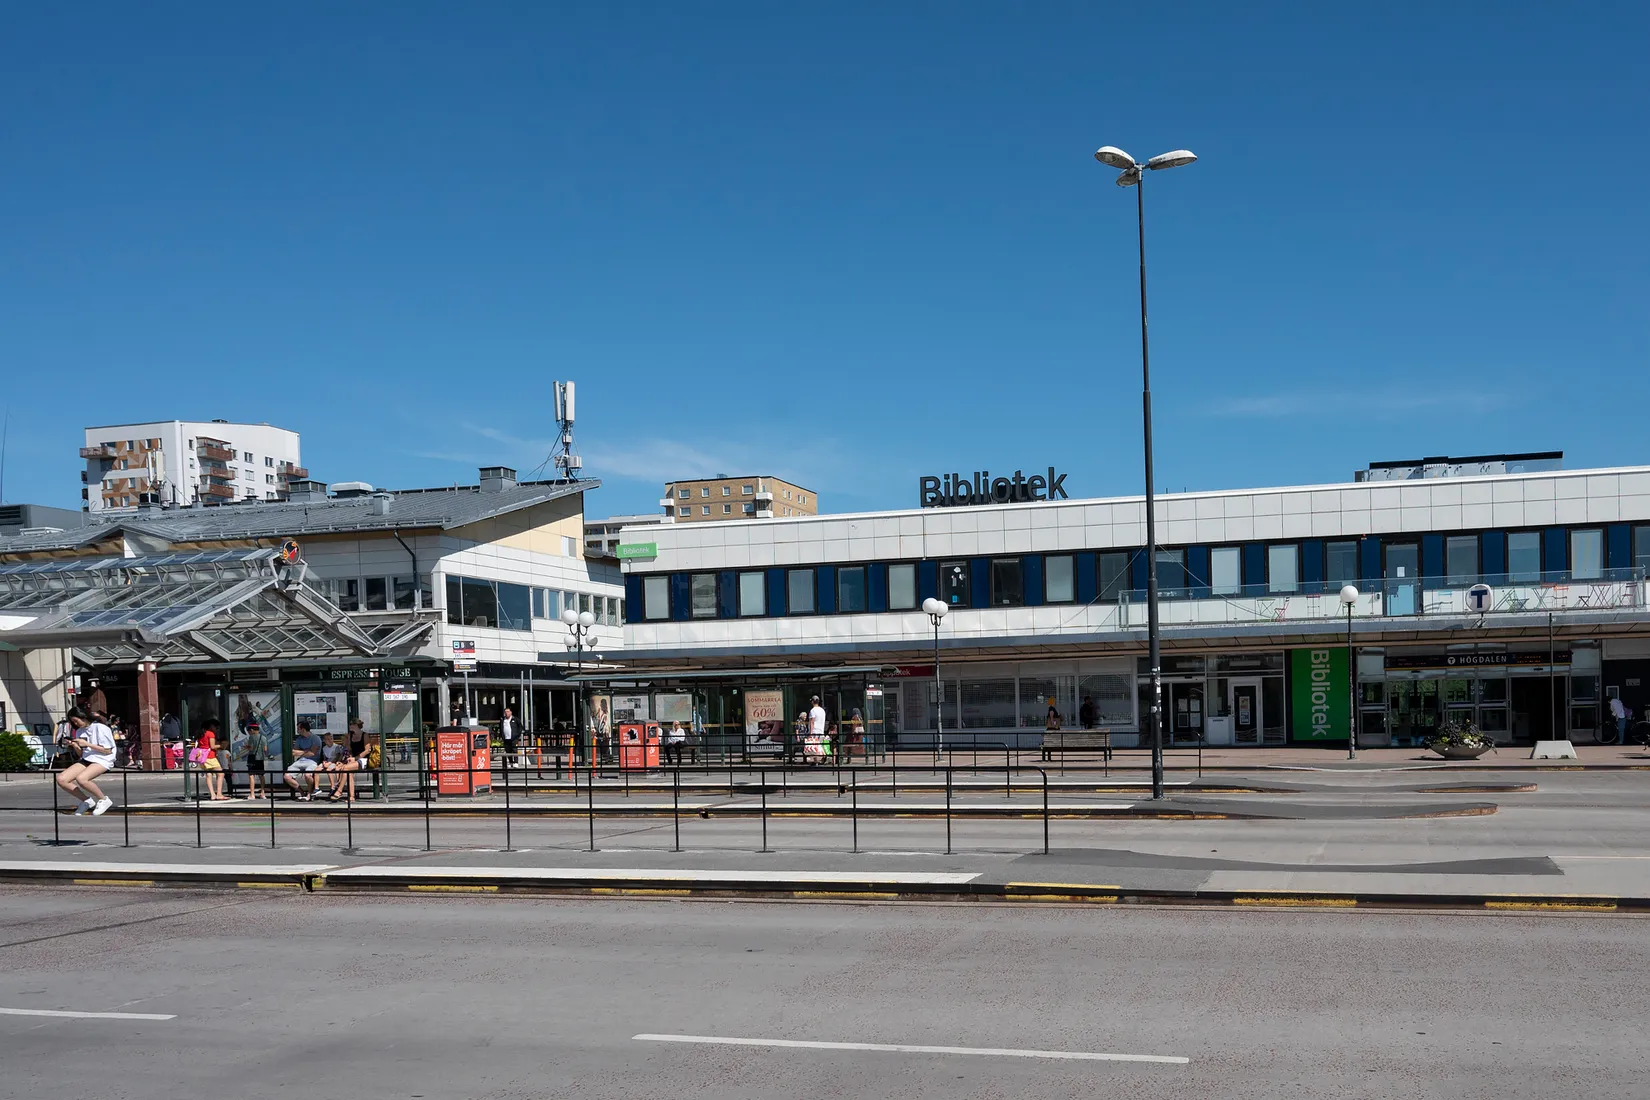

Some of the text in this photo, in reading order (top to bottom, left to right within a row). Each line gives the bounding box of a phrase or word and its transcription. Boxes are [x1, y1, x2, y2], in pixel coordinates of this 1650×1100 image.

[920, 467, 1068, 507] Bibliotek
[623, 546, 649, 554] Bibliotek
[1471, 590, 1488, 608] T
[1460, 655, 1507, 664] HÖGDALEN
[331, 668, 411, 679] ESPRESS OUSE
[1310, 650, 1331, 736] Bibliotek
[753, 708, 776, 718] 60%
